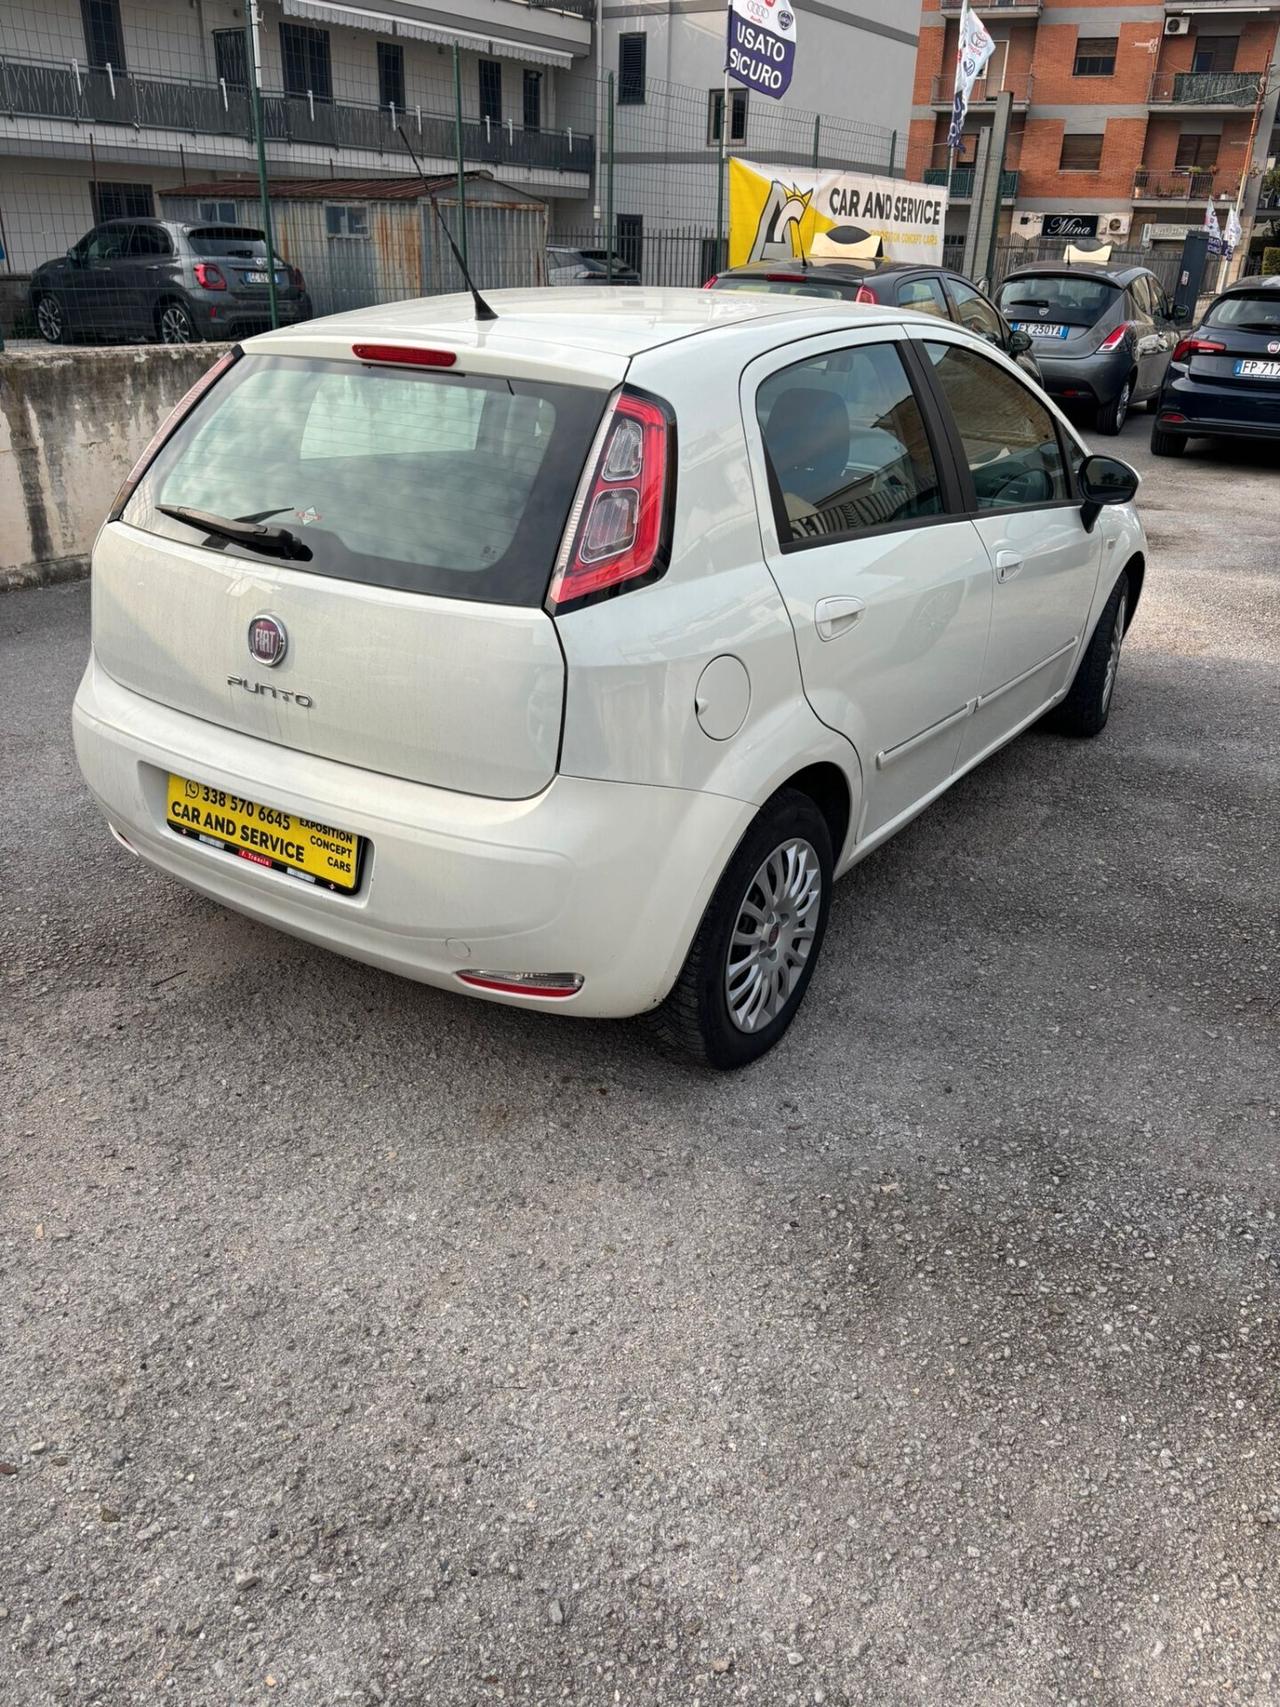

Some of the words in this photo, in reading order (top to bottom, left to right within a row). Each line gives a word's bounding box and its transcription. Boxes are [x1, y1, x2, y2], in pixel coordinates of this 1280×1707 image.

[737, 21, 785, 62] USATO
[729, 47, 782, 89] SICURO
[829, 187, 859, 217] CAR
[862, 191, 892, 221] AND
[893, 195, 942, 226] SERVICE
[1047, 216, 1091, 235] Mina
[1242, 361, 1258, 373] FP
[255, 628, 276, 654] FIAT
[227, 673, 313, 708] PUNTO
[202, 786, 226, 807] 338
[230, 796, 254, 817] 570
[258, 806, 290, 831] 6645
[171, 801, 201, 825] CAR
[203, 812, 236, 836] AND
[240, 824, 305, 863] SERVICE
[299, 817, 353, 845] EXPOSITION
[310, 835, 353, 858] CONCEPT
[327, 856, 352, 873] CARS
